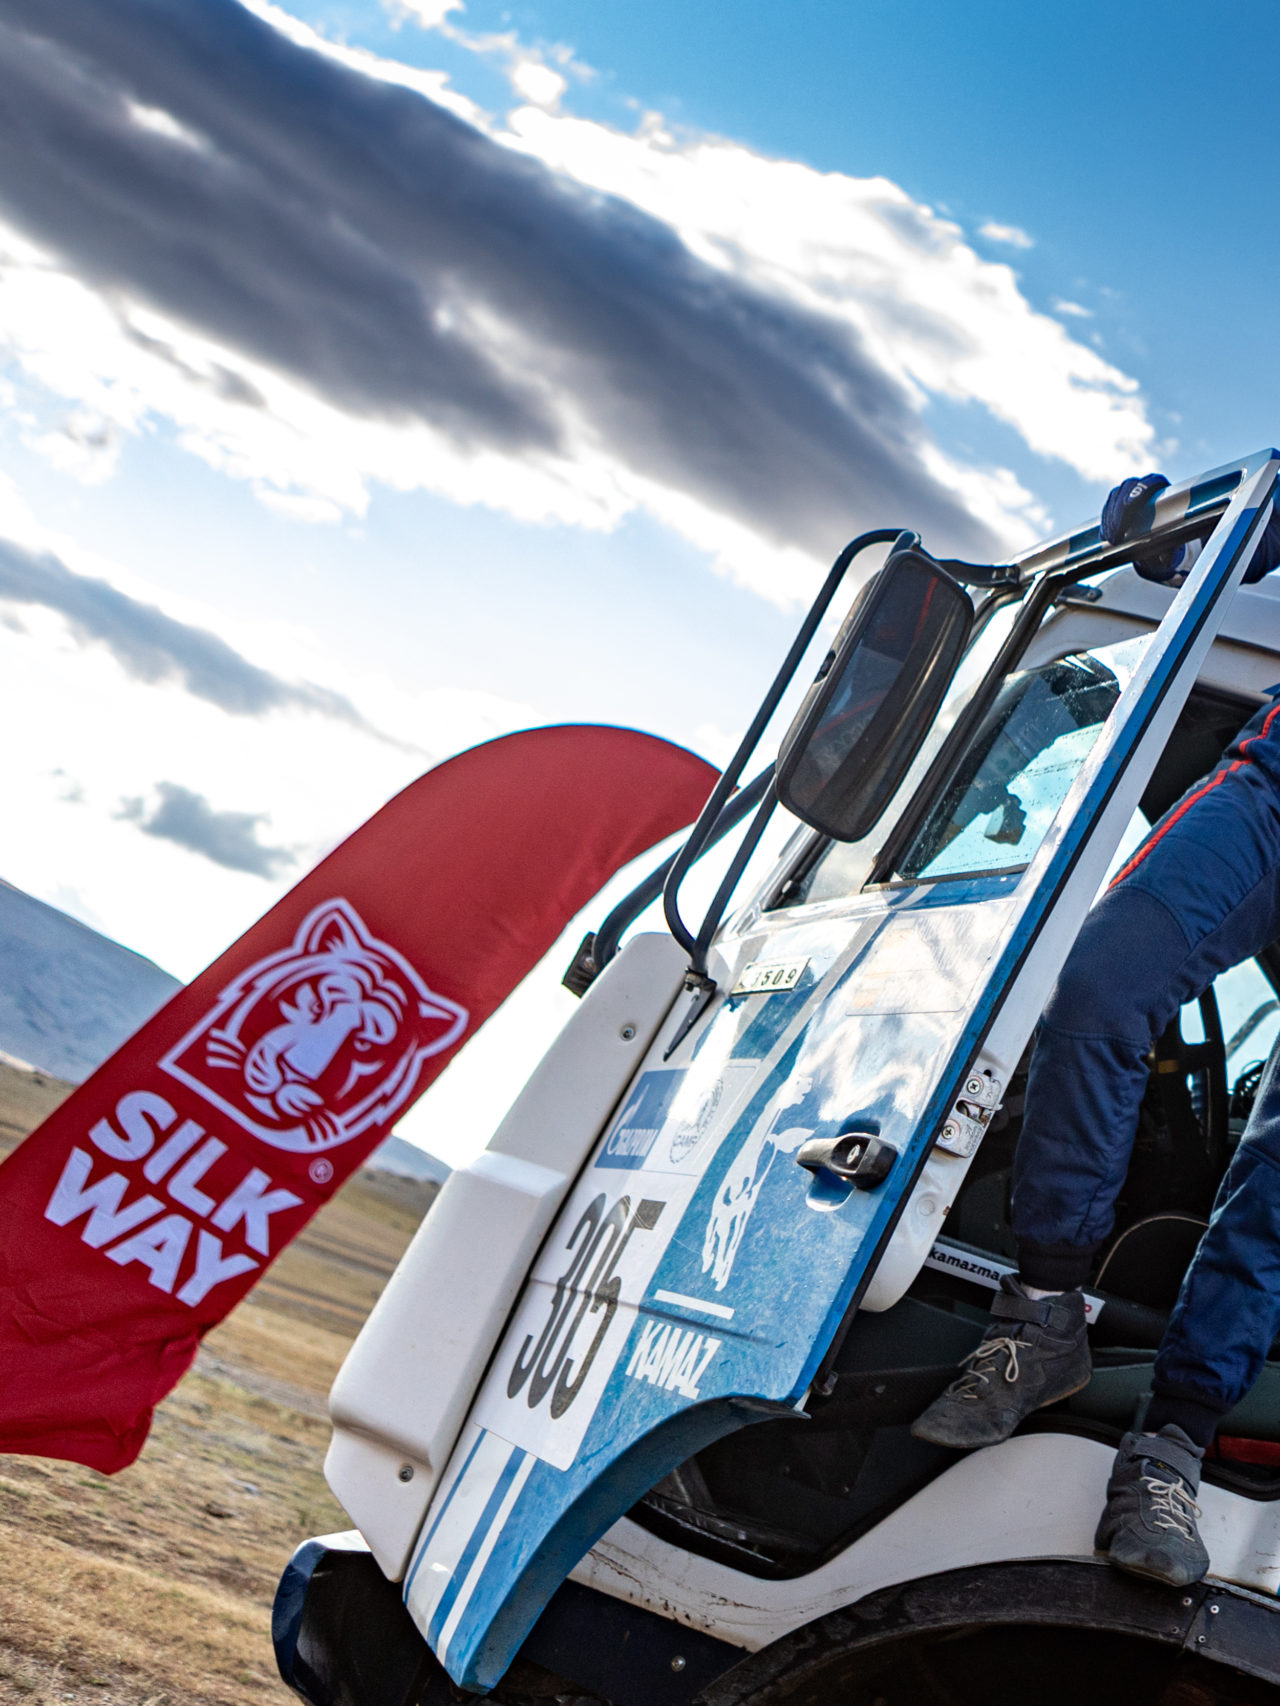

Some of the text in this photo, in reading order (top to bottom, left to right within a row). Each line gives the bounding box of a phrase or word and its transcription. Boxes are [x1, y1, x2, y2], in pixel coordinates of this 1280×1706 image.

[44, 1146, 260, 1308] WAY
[88, 1090, 304, 1257] SILK
[507, 1192, 667, 1420] 305
[929, 1248, 1001, 1282] kamazma
[625, 1320, 722, 1400] KAMAZ
